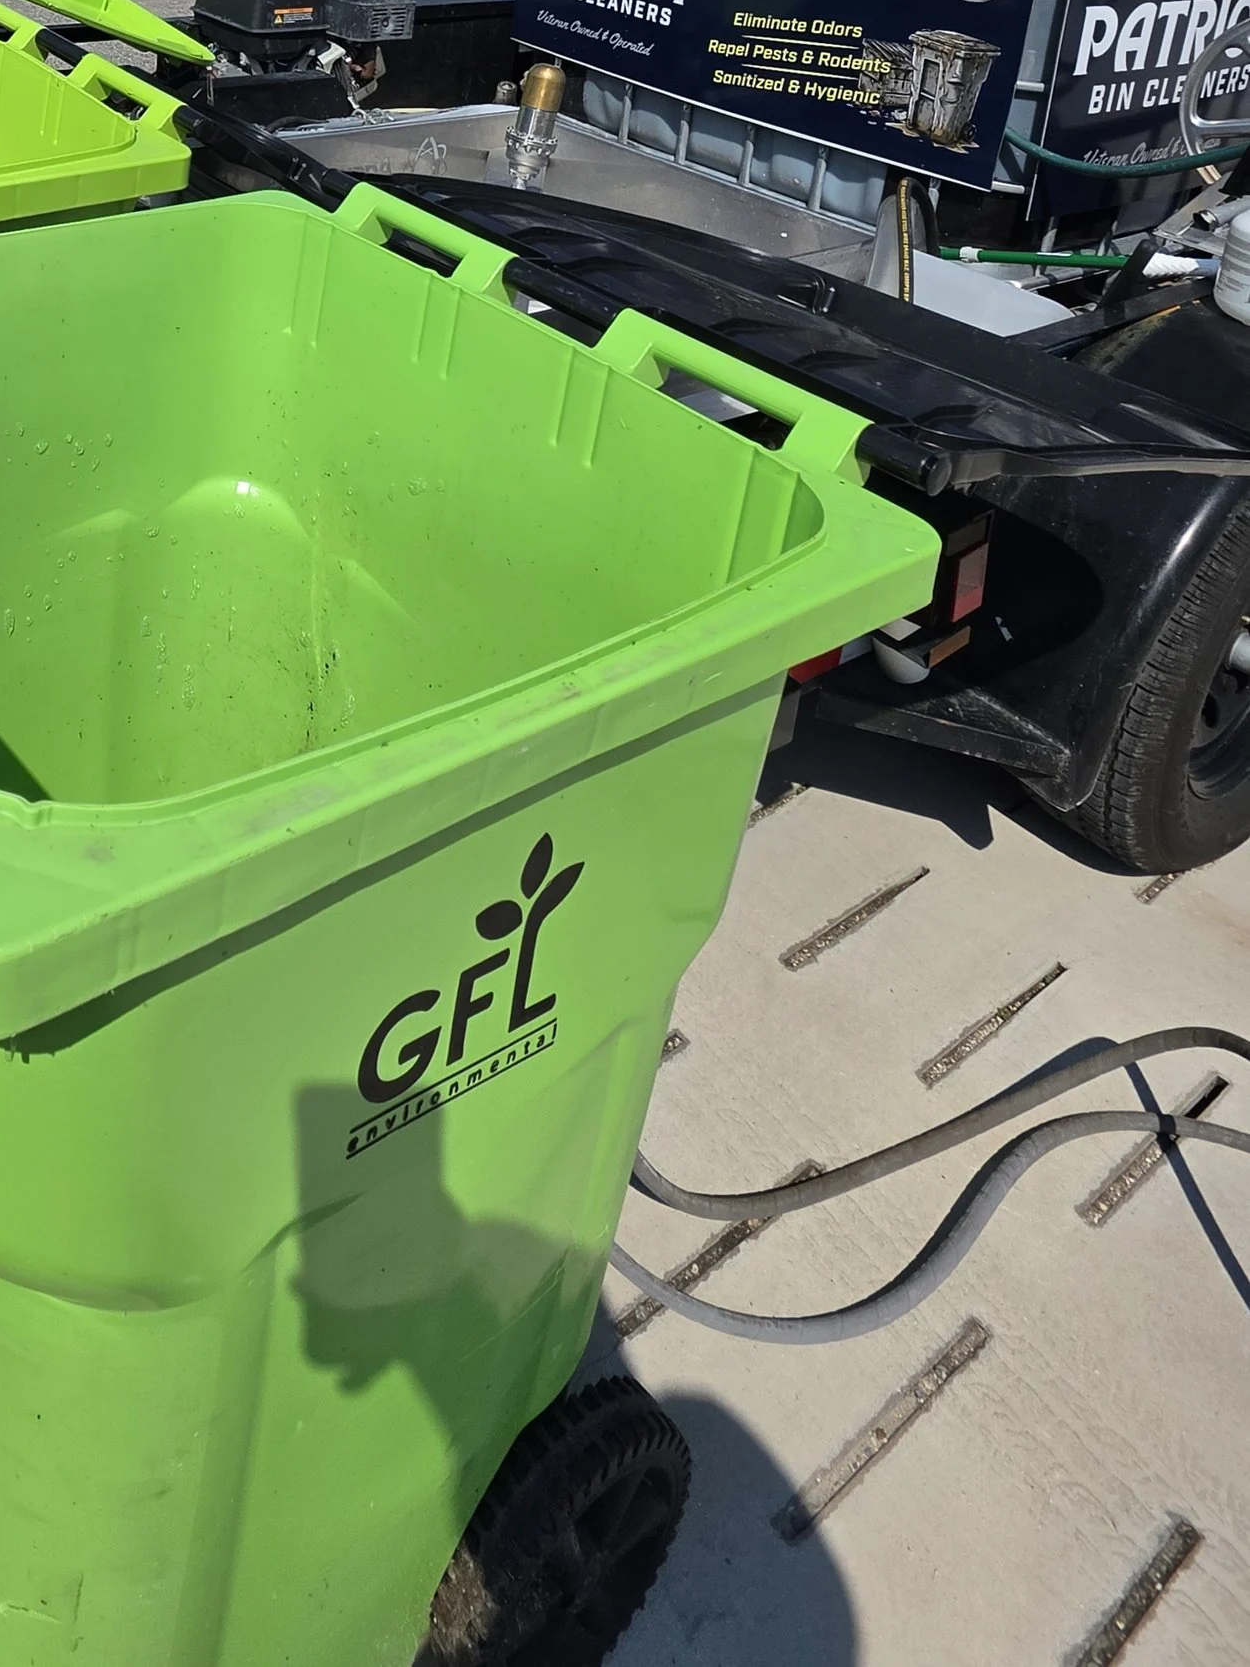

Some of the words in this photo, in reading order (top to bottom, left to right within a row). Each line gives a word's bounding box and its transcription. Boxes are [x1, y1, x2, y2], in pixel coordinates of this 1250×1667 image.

[536, 9, 569, 30] Veteran
[570, 20, 603, 40] Owned
[609, 32, 655, 56] Operated
[733, 12, 808, 33] Eliminate
[811, 19, 863, 38] Odors
[707, 39, 751, 57] Repel
[752, 44, 799, 63] Pests
[801, 50, 815, 65] &
[818, 51, 892, 74] Rodents
[712, 69, 786, 92] Sanitized
[787, 79, 801, 94] &
[803, 81, 881, 105] Hygienic
[1087, 81, 1136, 115] BIN
[1142, 64, 1250, 108] CLENERS
[1130, 136, 1176, 164] Owned
[357, 861, 584, 1104] GFL
[346, 1022, 558, 1154] environmental
